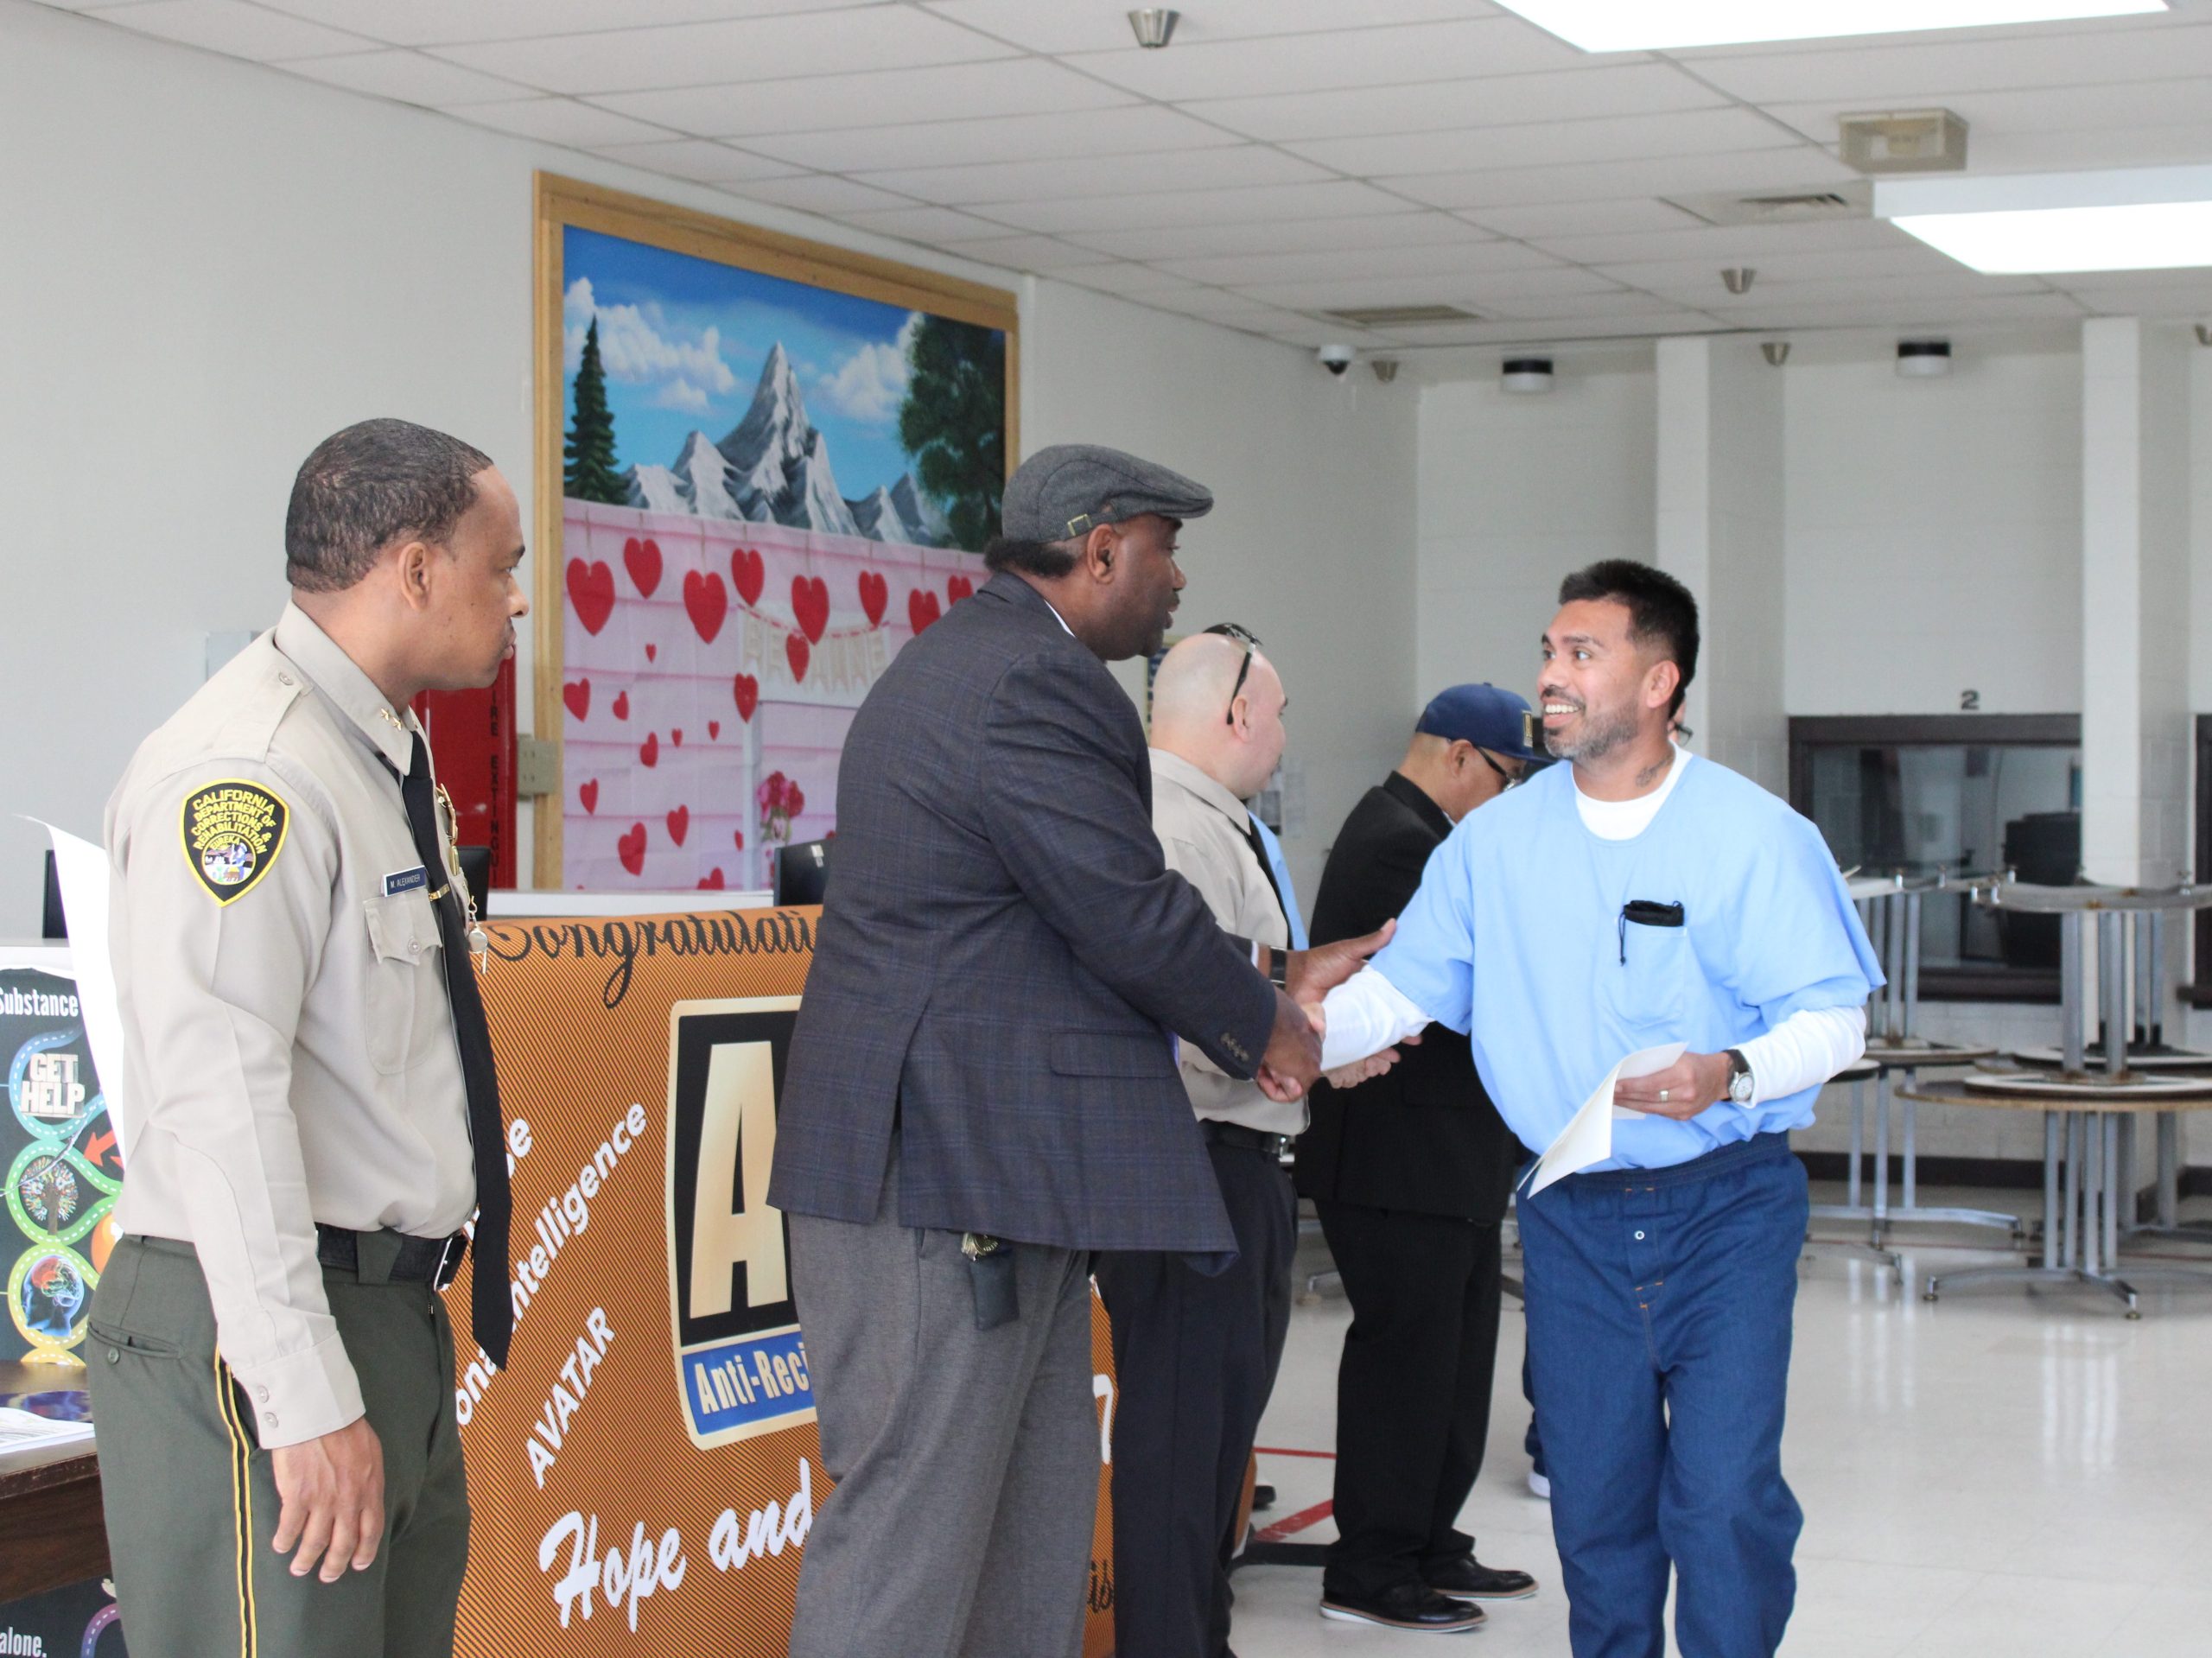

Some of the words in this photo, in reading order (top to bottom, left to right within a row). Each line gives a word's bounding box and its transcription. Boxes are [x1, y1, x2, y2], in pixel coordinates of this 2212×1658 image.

[490, 687, 499, 737] IRE
[1961, 689, 1980, 710] 2
[193, 789, 276, 816] CALIFORNIA
[194, 801, 264, 822] DEPARTMENT
[261, 815, 276, 828] OF
[191, 811, 263, 836] CORRECTIONS
[261, 832, 272, 843] &
[490, 754, 499, 888] EXTINGUI
[193, 822, 268, 854] REHABILITATION
[209, 835, 240, 849] EUREKA
[397, 873, 421, 887] ALEXANDER
[486, 910, 823, 1009] Congratulati
[29, 1053, 79, 1083] GET
[21, 1081, 86, 1115] HELP
[512, 1103, 646, 1333] ntelligence
[527, 1306, 616, 1490] AVATAR
[539, 1511, 687, 1633] Hope
[709, 1457, 813, 1572] and
